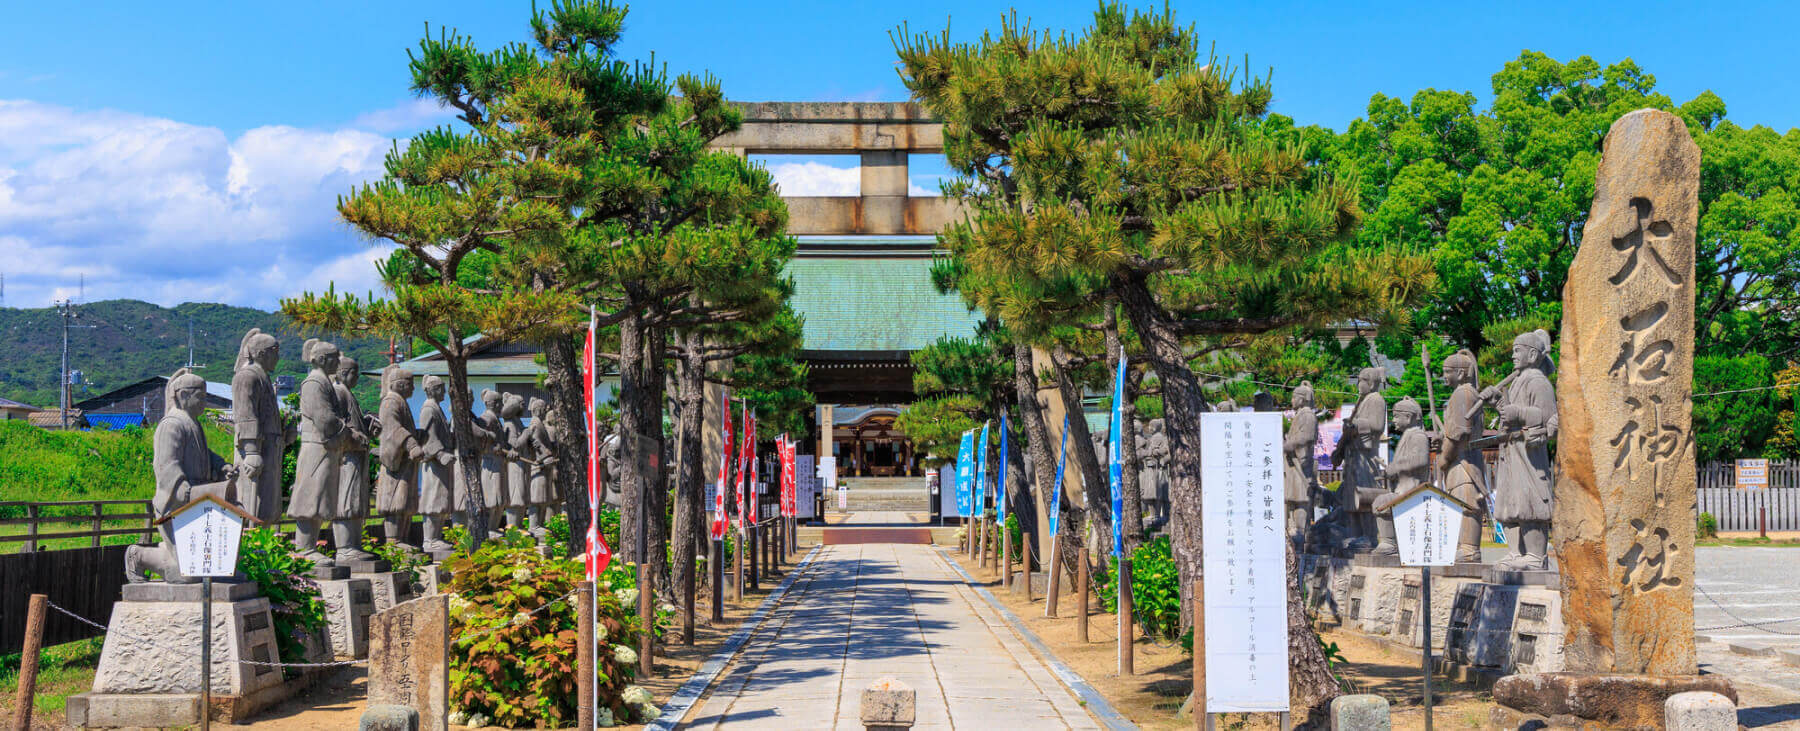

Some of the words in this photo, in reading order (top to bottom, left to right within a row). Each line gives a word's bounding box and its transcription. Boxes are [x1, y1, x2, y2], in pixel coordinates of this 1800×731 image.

[1263, 442, 1274, 532] ご参拝の皆様へ
[1608, 196, 1683, 593] 大石神社
